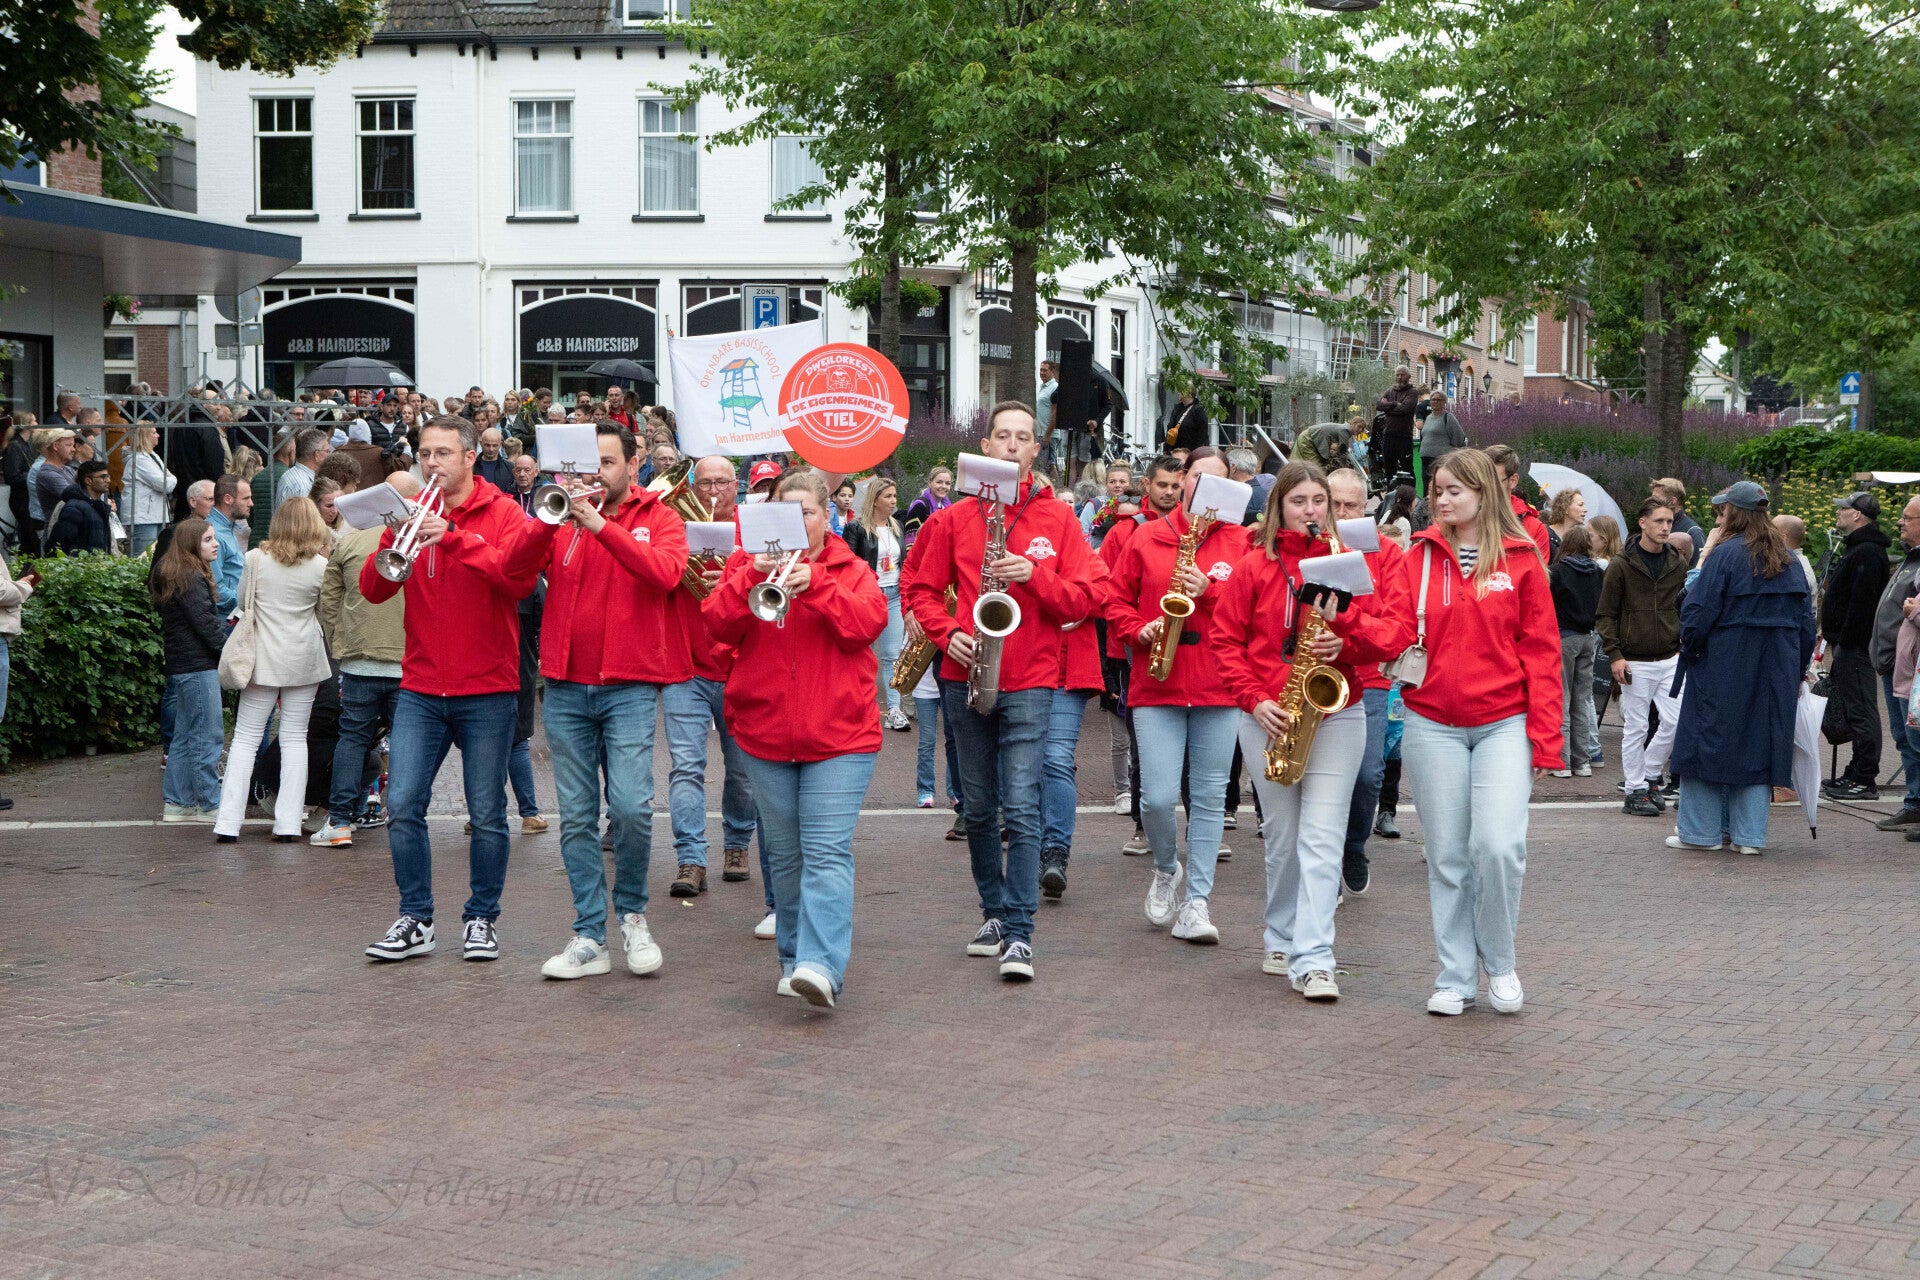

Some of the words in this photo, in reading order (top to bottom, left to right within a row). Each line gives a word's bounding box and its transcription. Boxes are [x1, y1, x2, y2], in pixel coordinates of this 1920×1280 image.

[759, 300, 773, 319] P
[287, 338, 314, 353] B&B
[317, 337, 391, 353] HAIRDESIGN
[536, 338, 562, 353] B&B
[566, 337, 639, 353] HAIRDESIGN
[700, 340, 734, 389] OPENBARE
[734, 337, 782, 380] BASISSCHOOL
[791, 404, 807, 414] DE
[822, 411, 858, 428] TIEL
[715, 433, 729, 446] Jan
